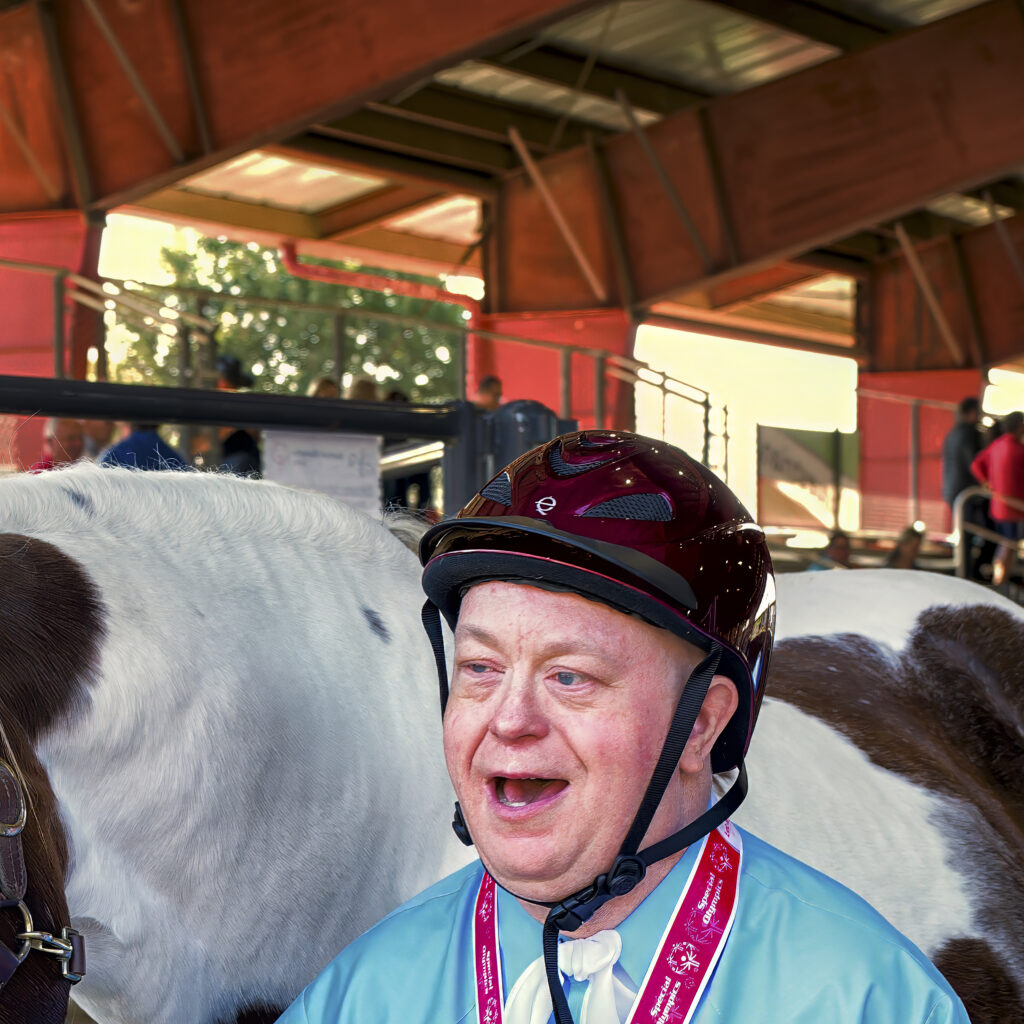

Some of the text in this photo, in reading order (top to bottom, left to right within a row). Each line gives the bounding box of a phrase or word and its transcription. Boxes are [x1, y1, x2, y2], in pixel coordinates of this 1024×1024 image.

[698, 872, 716, 910] Special
[702, 879, 724, 925] Olympics
[651, 976, 672, 1019] Special
